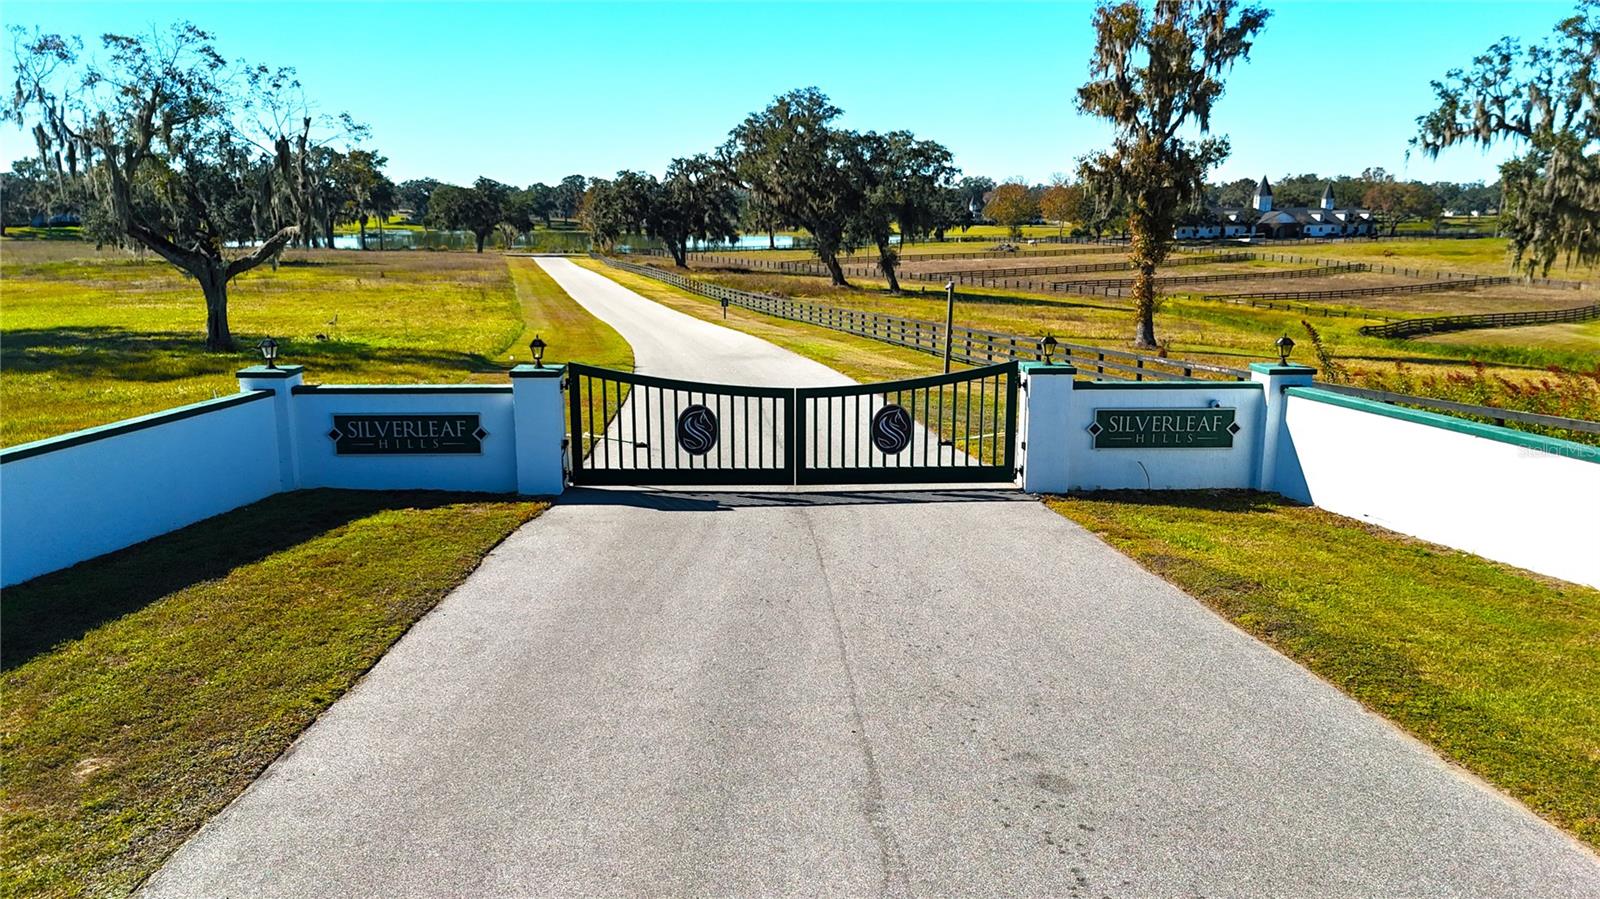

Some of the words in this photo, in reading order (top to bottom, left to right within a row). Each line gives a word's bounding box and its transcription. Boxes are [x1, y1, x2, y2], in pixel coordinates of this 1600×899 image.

[347, 420, 466, 438] SILVERLEAF
[1108, 415, 1223, 433] SILVERLEAF
[378, 439, 439, 449] HILLS
[1135, 433, 1193, 443] HILLS
